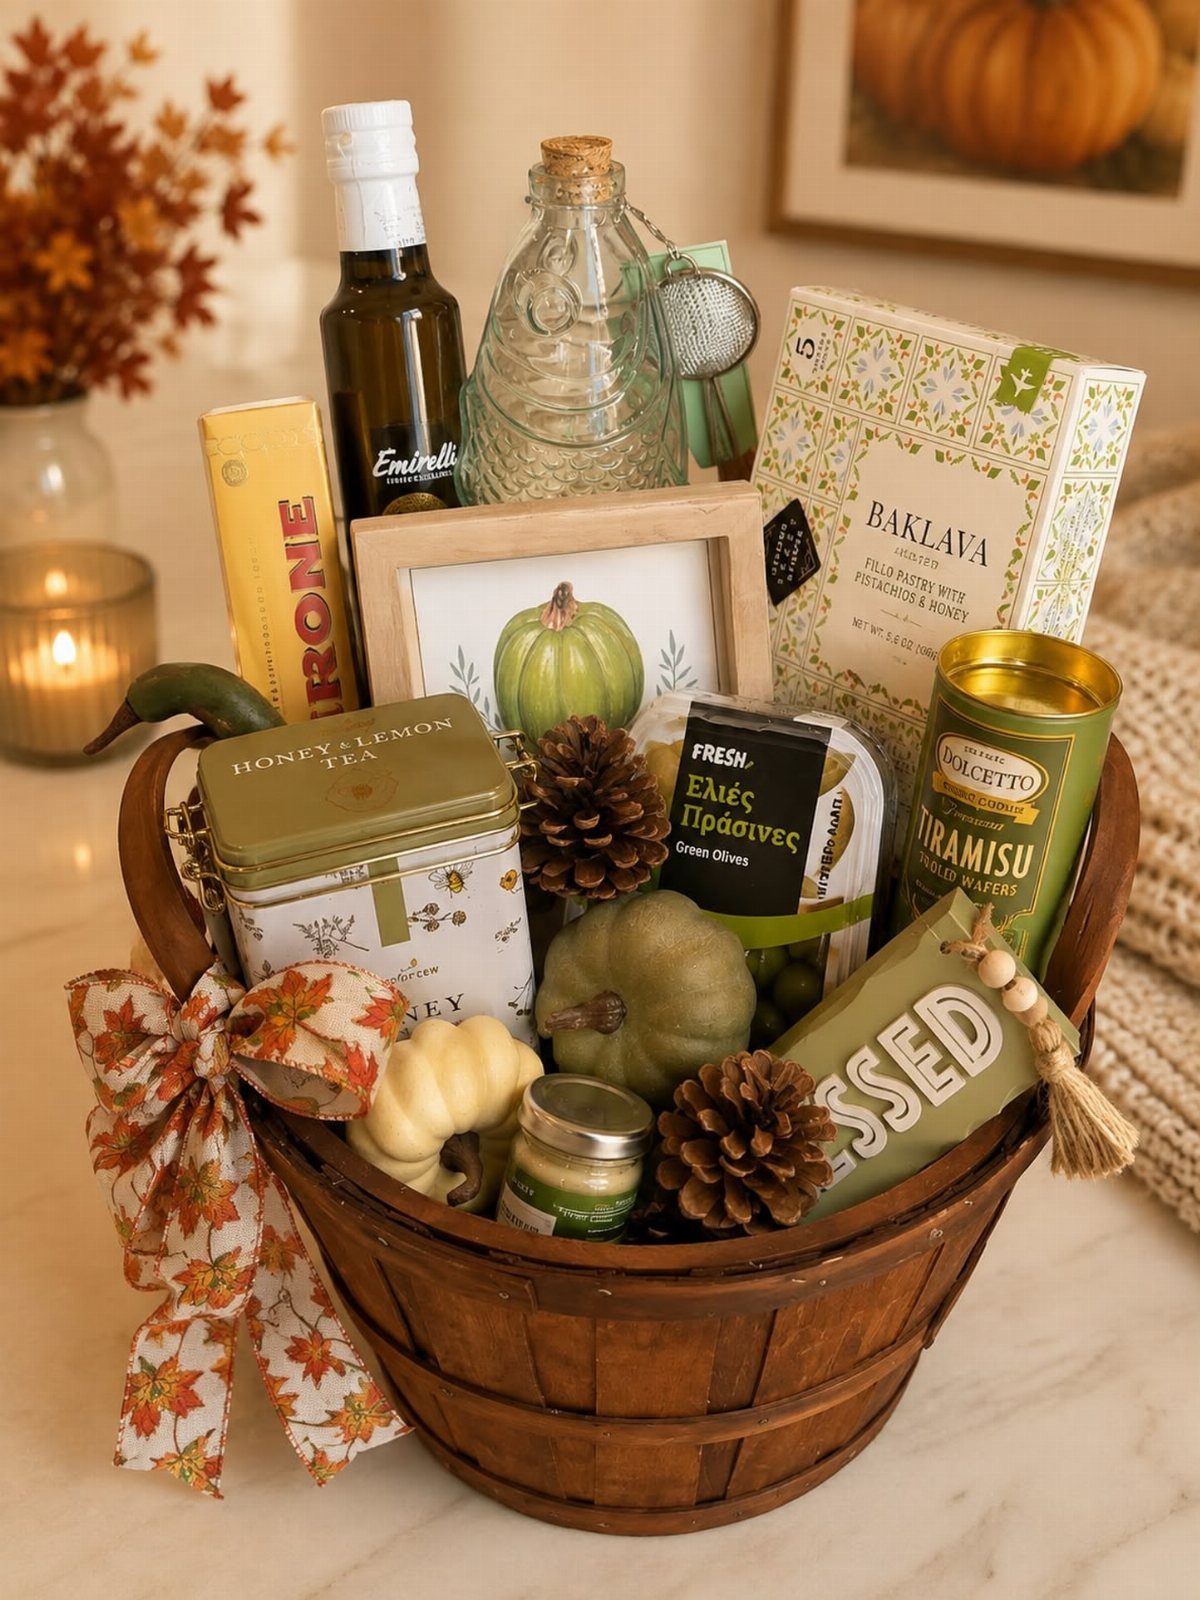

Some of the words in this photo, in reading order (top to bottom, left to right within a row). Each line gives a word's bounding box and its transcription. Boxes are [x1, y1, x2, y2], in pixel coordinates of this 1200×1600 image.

[796, 337, 815, 359] 5
[372, 441, 457, 477] Emirelli
[866, 500, 988, 567] BAKLAVA
[854, 571, 917, 604] PISTACHIOS
[928, 601, 970, 623] HONEY
[865, 557, 894, 577] FILLO
[896, 570, 936, 594] PASTRY
[938, 584, 966, 604] WITH
[232, 742, 332, 776] HONEY
[339, 741, 352, 751] &
[354, 718, 454, 748] LEMON
[319, 750, 378, 770] TEA
[942, 745, 1035, 791] DOLCETTO
[686, 774, 755, 814] Ελιές
[680, 803, 800, 854] Πράσινες
[918, 805, 1034, 879] TIRAMISU
[675, 840, 710, 860] Green
[712, 849, 749, 868] Olives
[961, 875, 1018, 897] WAFERS
